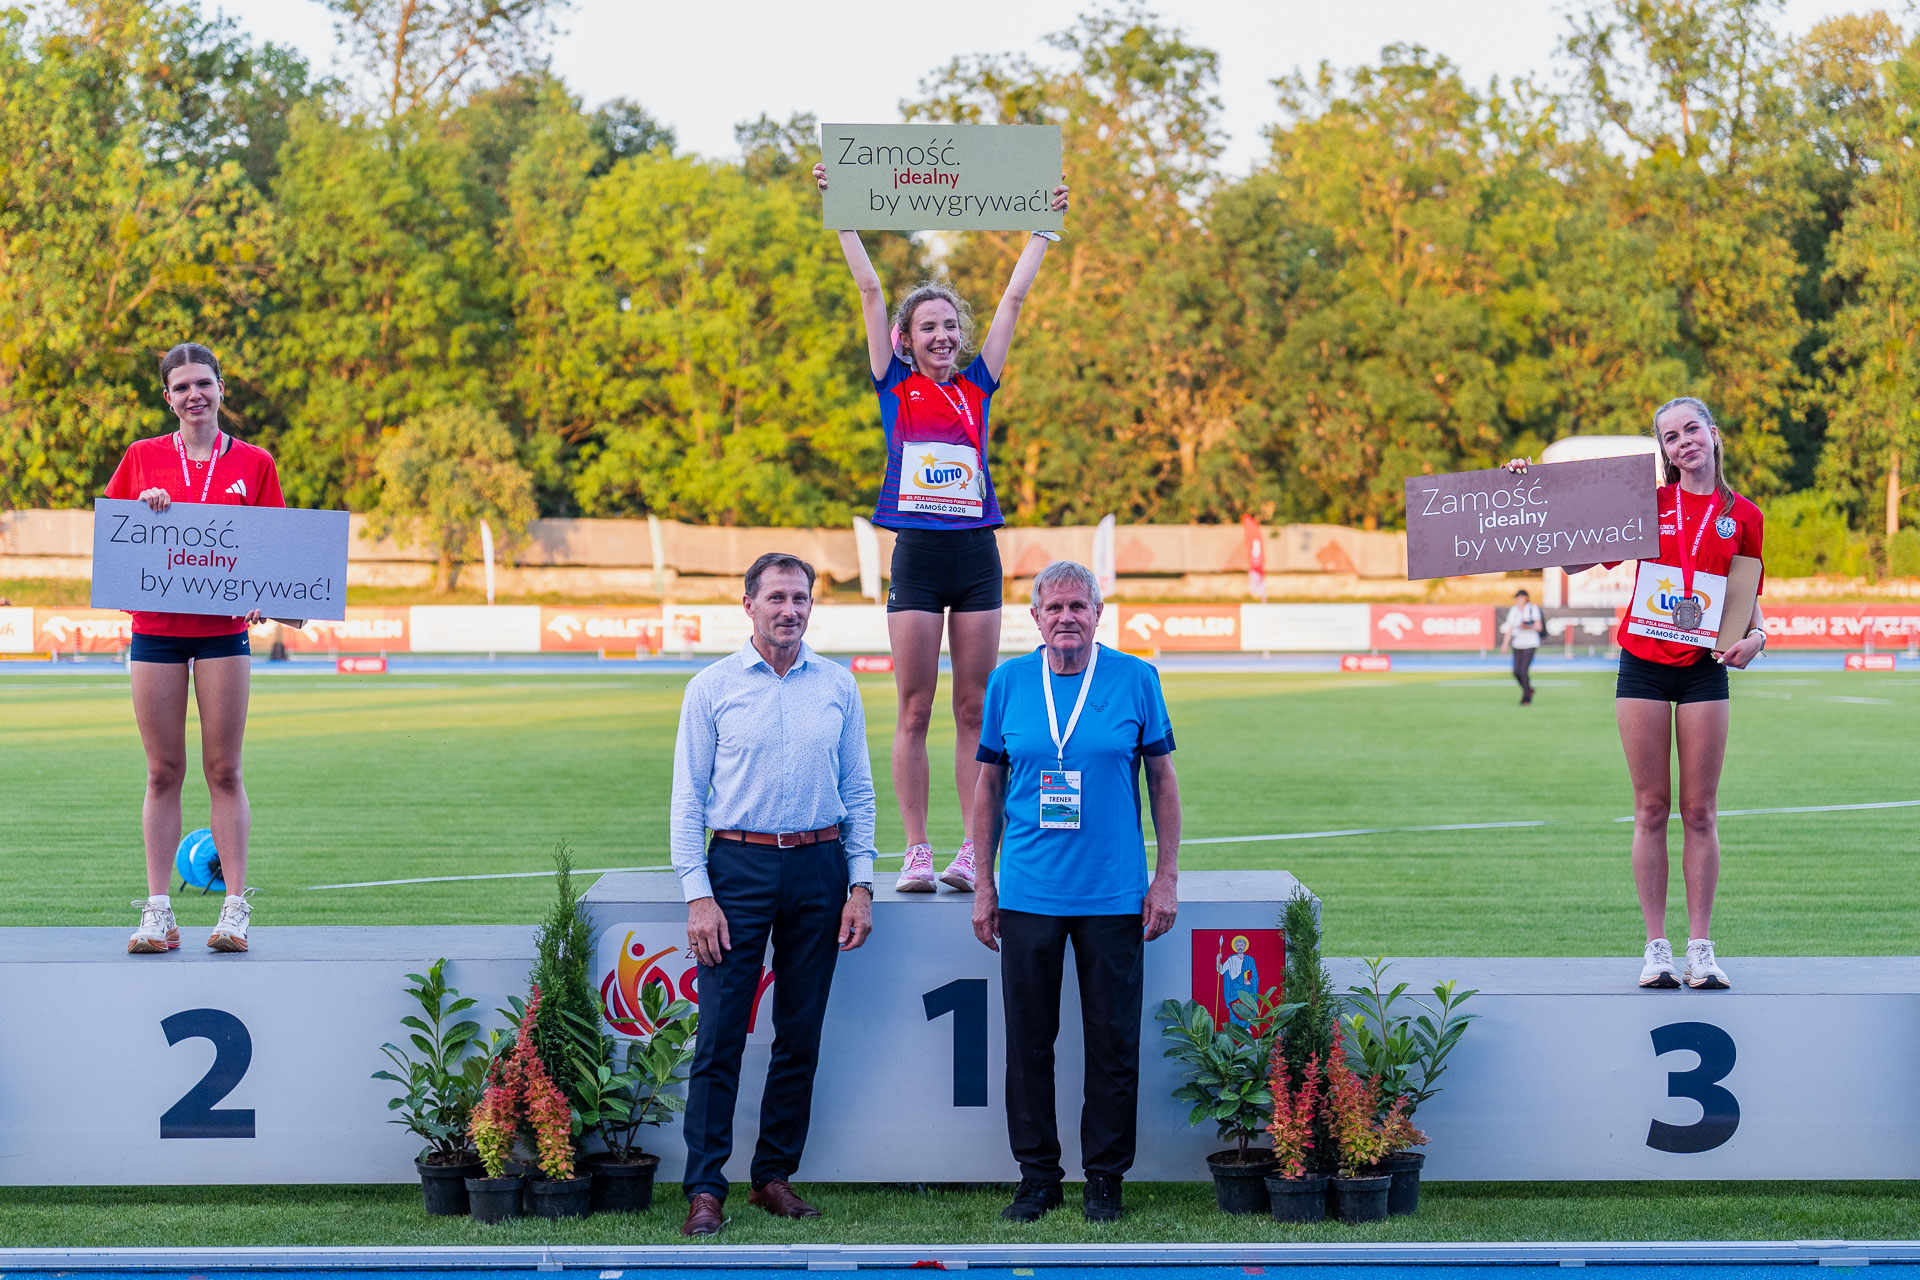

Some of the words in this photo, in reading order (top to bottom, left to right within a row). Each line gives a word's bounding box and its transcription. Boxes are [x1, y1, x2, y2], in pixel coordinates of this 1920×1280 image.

[838, 137, 960, 166] Zamość.
[870, 188, 901, 216] by
[908, 189, 1049, 216] wygrywać!
[926, 468, 962, 484] LOTTO
[915, 503, 948, 512] ZAMOŚĆ
[1422, 478, 1548, 516] Zamość.
[110, 514, 239, 549] Zamość.
[1454, 535, 1487, 561] by
[1494, 518, 1644, 556] wygrywać!
[141, 568, 174, 598] by
[182, 577, 330, 602] wygrywać!
[1646, 628, 1678, 640] ZAMOŚĆ
[1680, 634, 1699, 643] 2026
[922, 979, 988, 1106] 1
[160, 1008, 256, 1139] 2
[1646, 1022, 1740, 1154] 3
